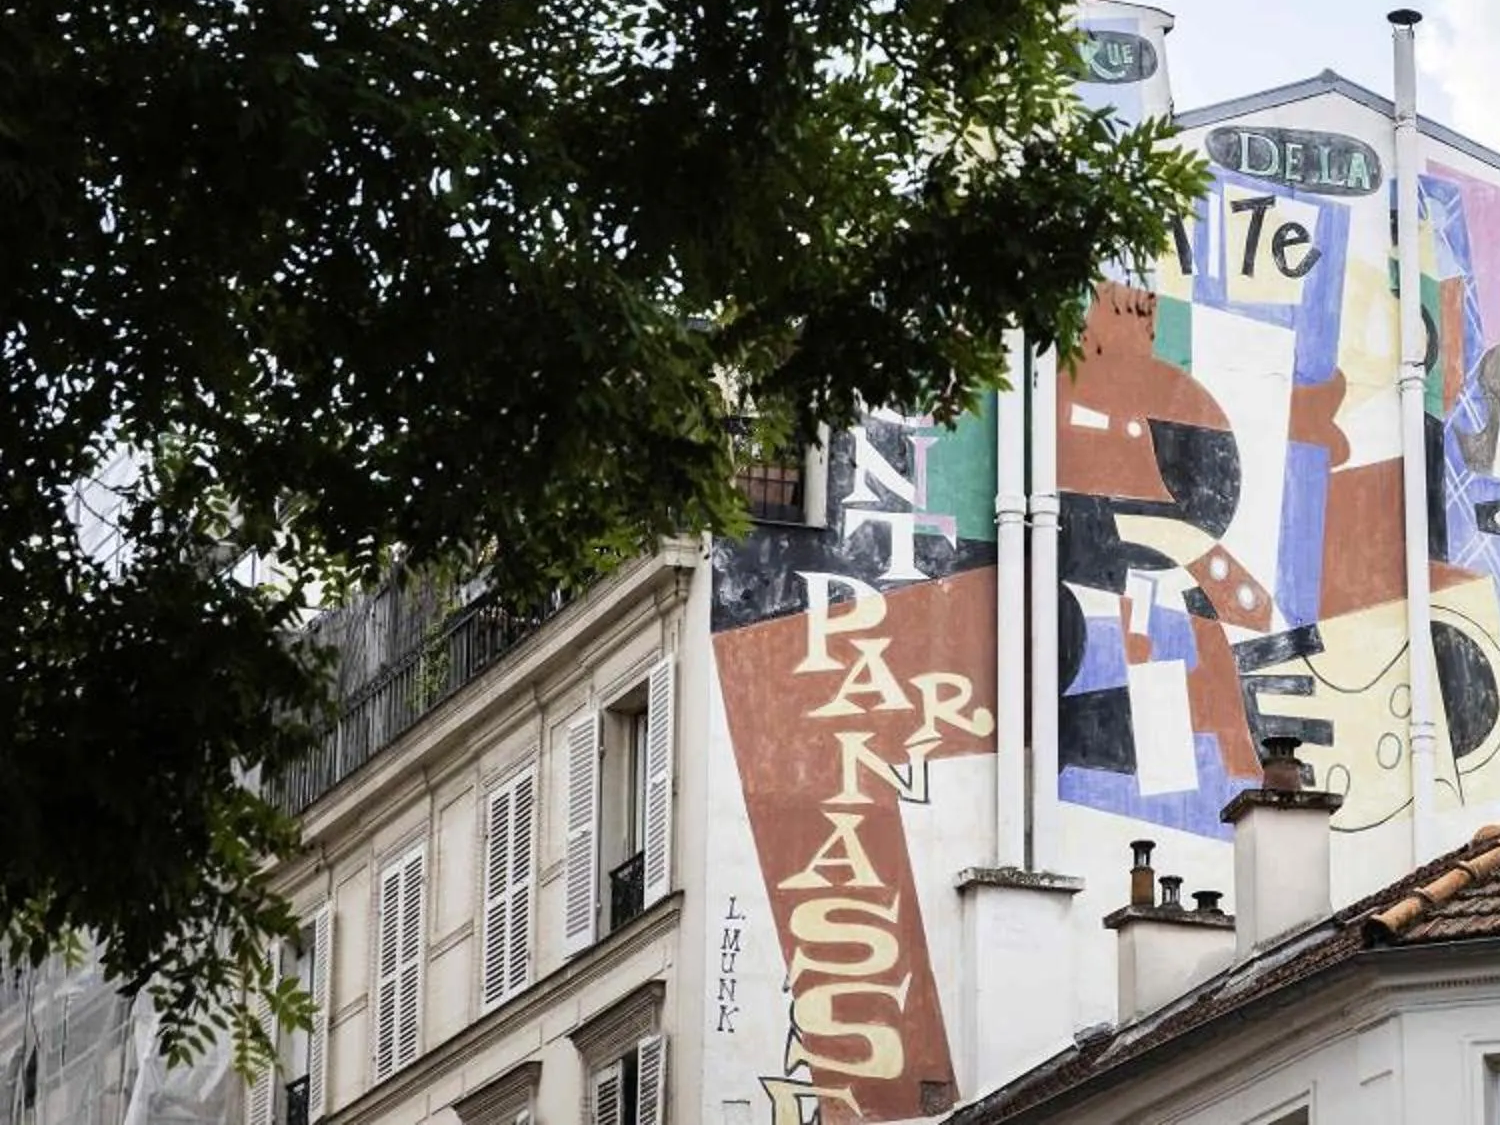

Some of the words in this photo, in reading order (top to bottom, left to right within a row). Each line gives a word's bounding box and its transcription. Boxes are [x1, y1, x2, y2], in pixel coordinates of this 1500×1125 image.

[1239, 132, 1304, 181] DE
[1317, 144, 1371, 189] LA
[717, 928, 741, 1032] MUNK
